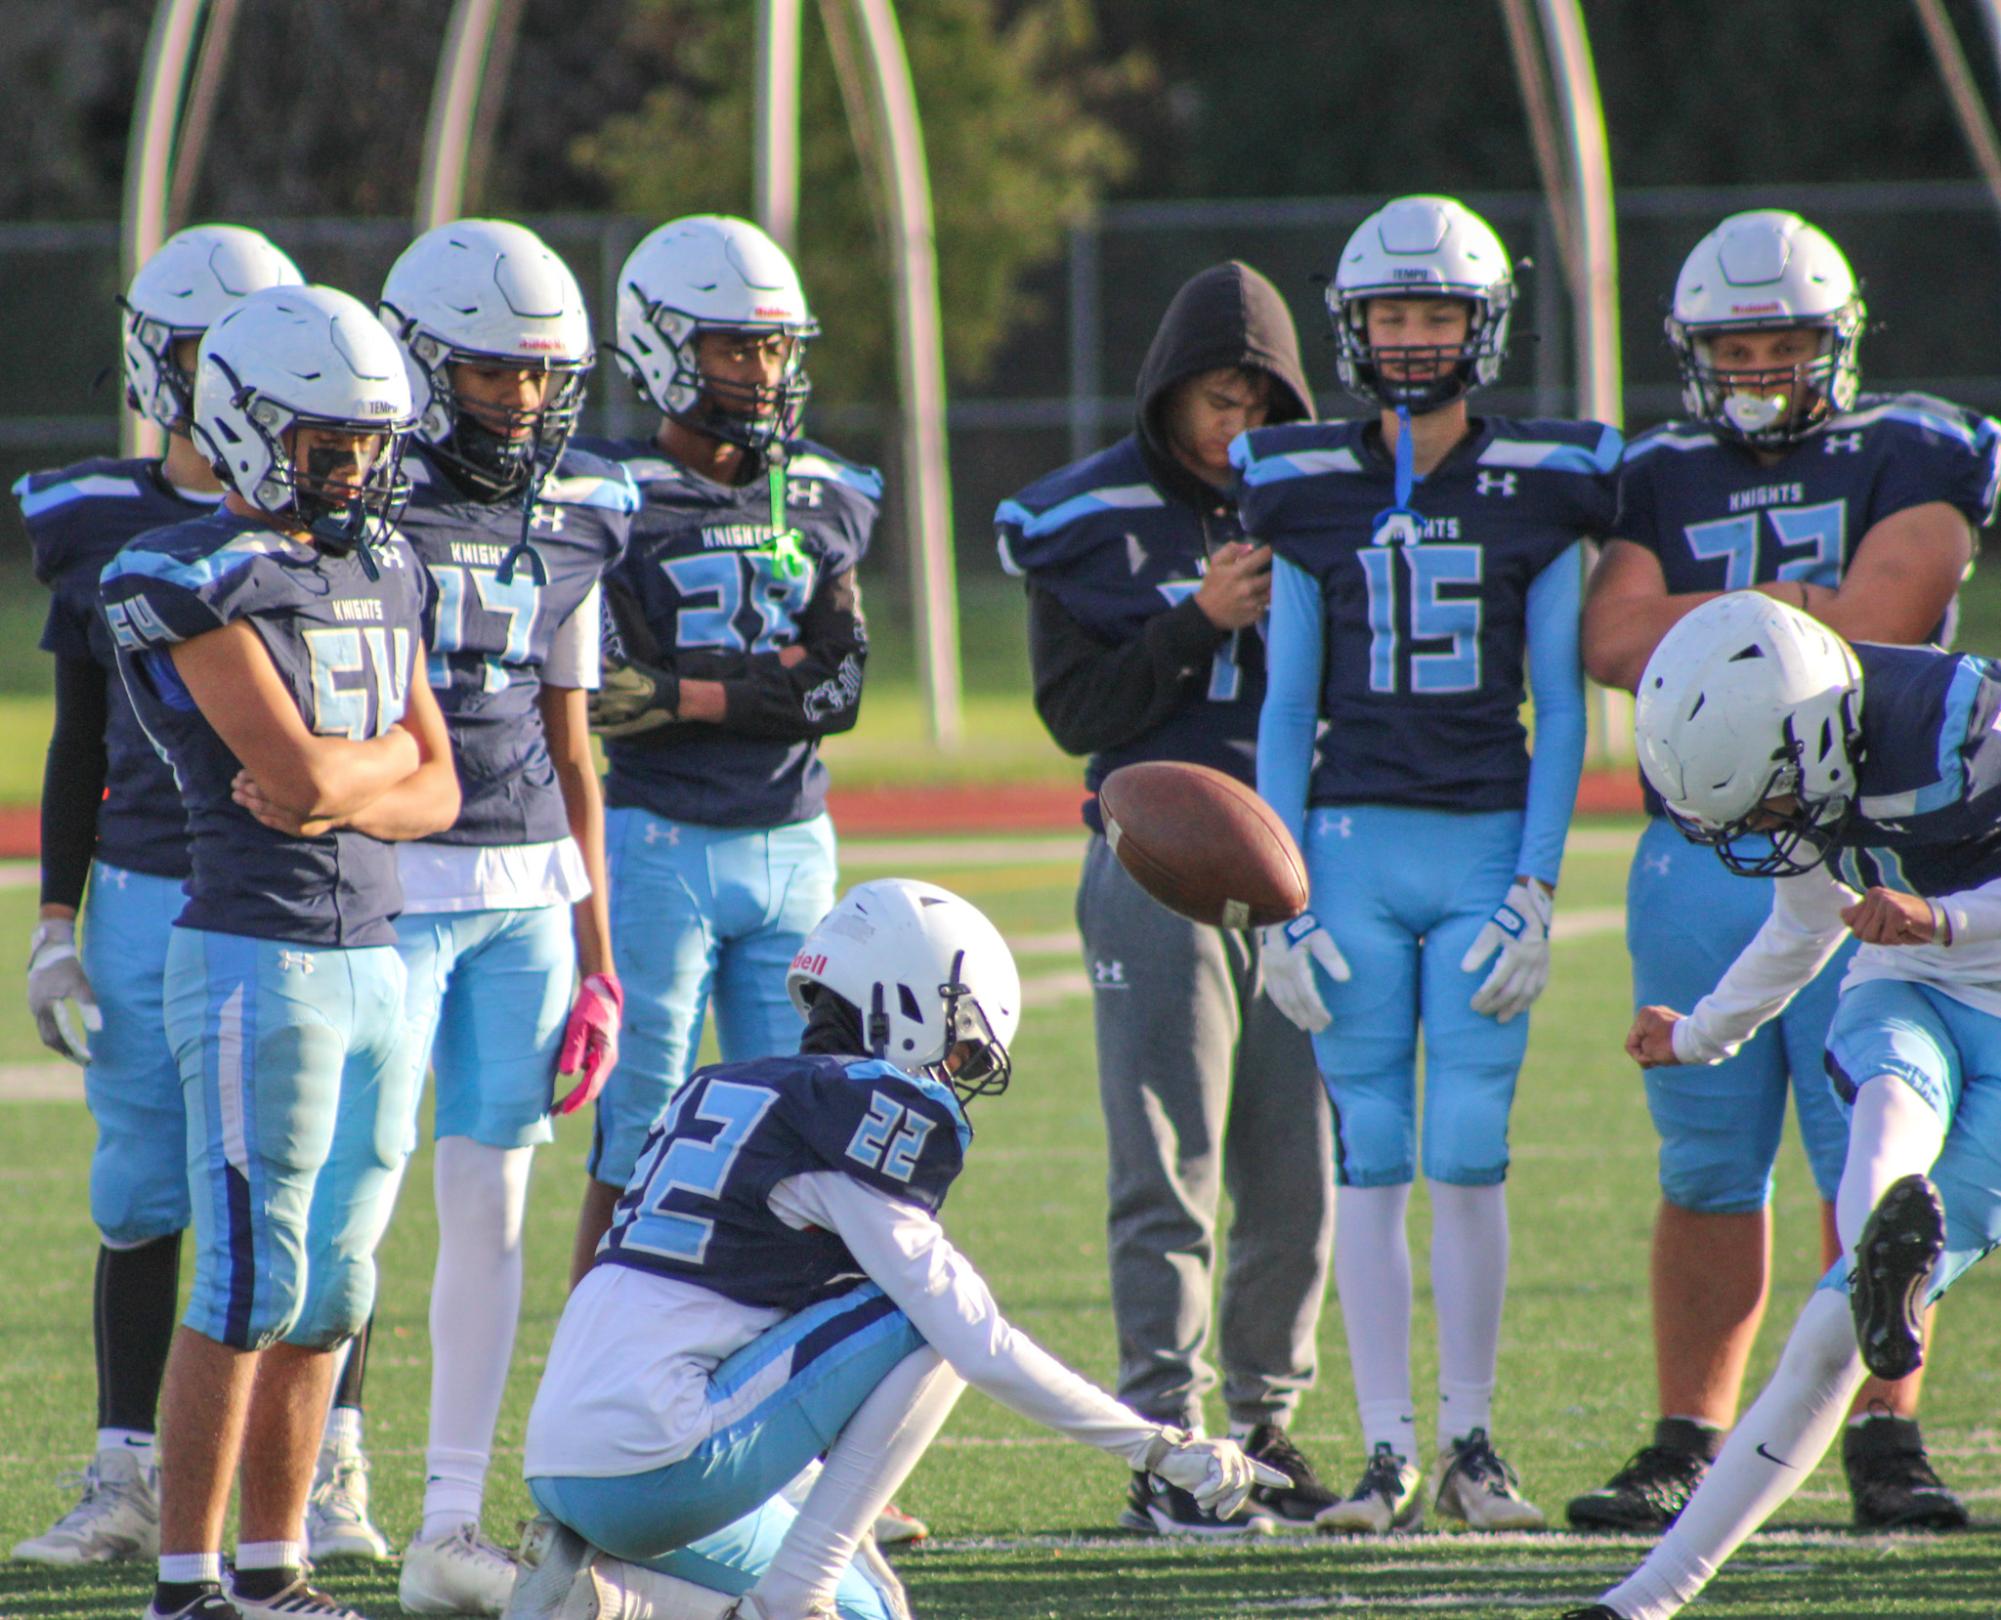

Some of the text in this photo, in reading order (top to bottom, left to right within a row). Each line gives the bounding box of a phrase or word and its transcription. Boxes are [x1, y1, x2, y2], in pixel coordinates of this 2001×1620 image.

[1729, 483, 1803, 511] KNIGHTS
[451, 542, 520, 568] KNIGHT
[332, 599, 383, 621] KNIGHTS
[1357, 544, 1483, 693] 15
[302, 626, 409, 741] 54
[792, 951, 828, 976] dell
[844, 1089, 938, 1184] 22
